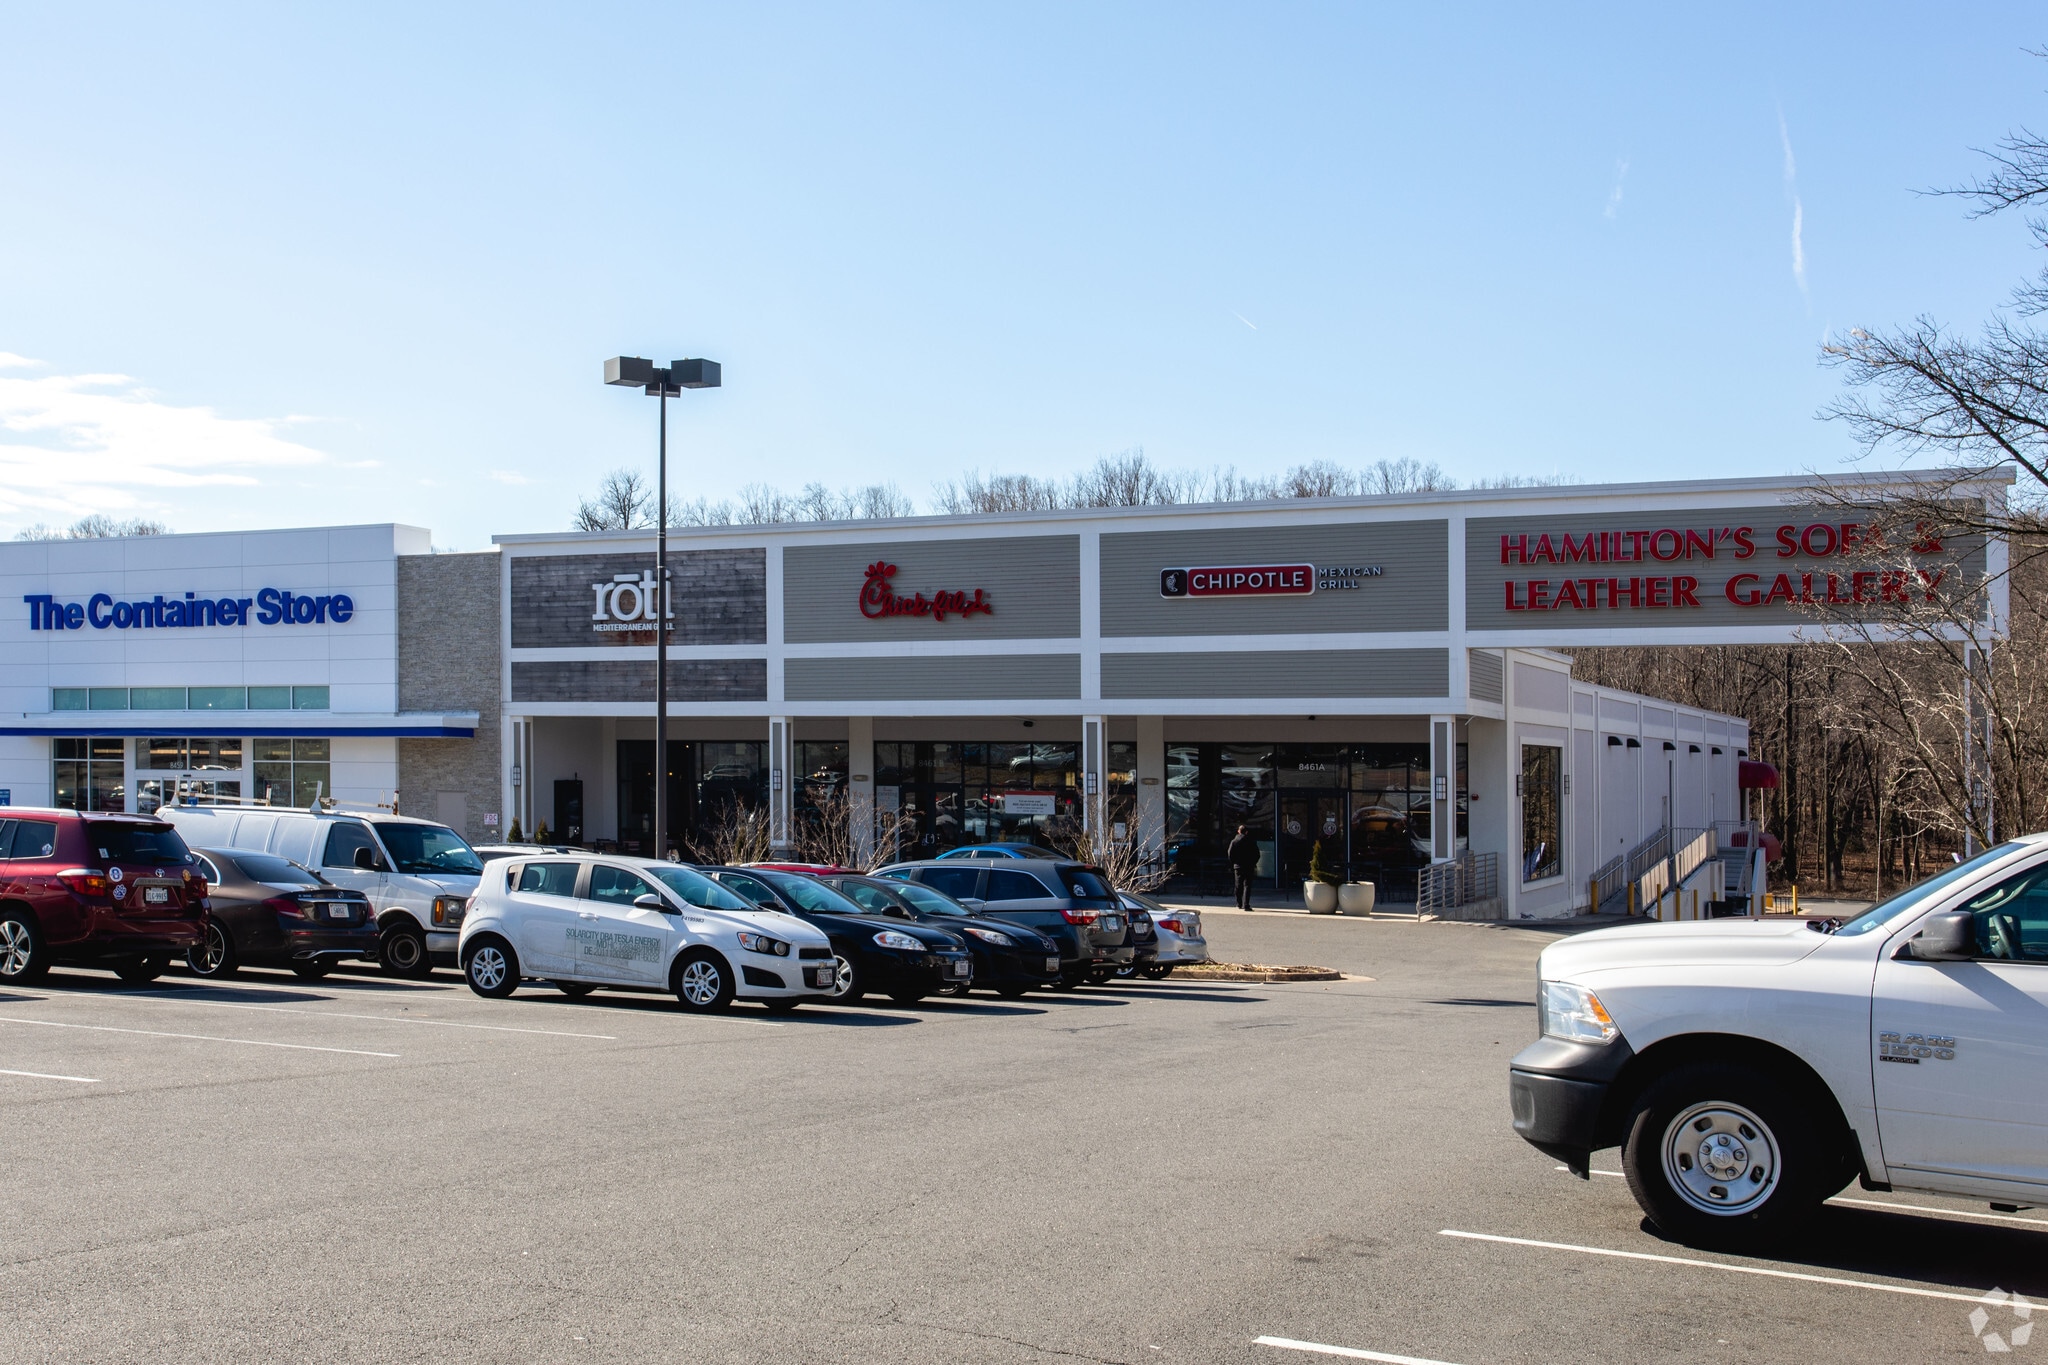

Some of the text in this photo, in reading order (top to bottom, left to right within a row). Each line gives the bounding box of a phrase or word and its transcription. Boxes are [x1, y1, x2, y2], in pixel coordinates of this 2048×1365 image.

[1501, 527, 1756, 564] HAMILTON'S
[1775, 523, 1888, 557] SOFA
[1192, 571, 1305, 589] CHIPOTLE
[1318, 567, 1383, 578] MEXICAN
[859, 561, 992, 622] Chick-fil-A
[1318, 579, 1360, 590] GRILL
[1504, 570, 1946, 611] LEATHER GALLERY
[24, 587, 354, 631] The Container Store
[593, 622, 676, 632] MEDITERRANEAN GLL
[169, 761, 184, 769] 8459
[1298, 763, 1326, 771] 8461A
[566, 928, 661, 947] SOLARCITY DBA TESLA ENERGY
[583, 946, 593, 955] DE
[1880, 1031, 1955, 1048] RAM
[1880, 1043, 1955, 1060] 1500
[1880, 1056, 1919, 1064] CLASSIC
